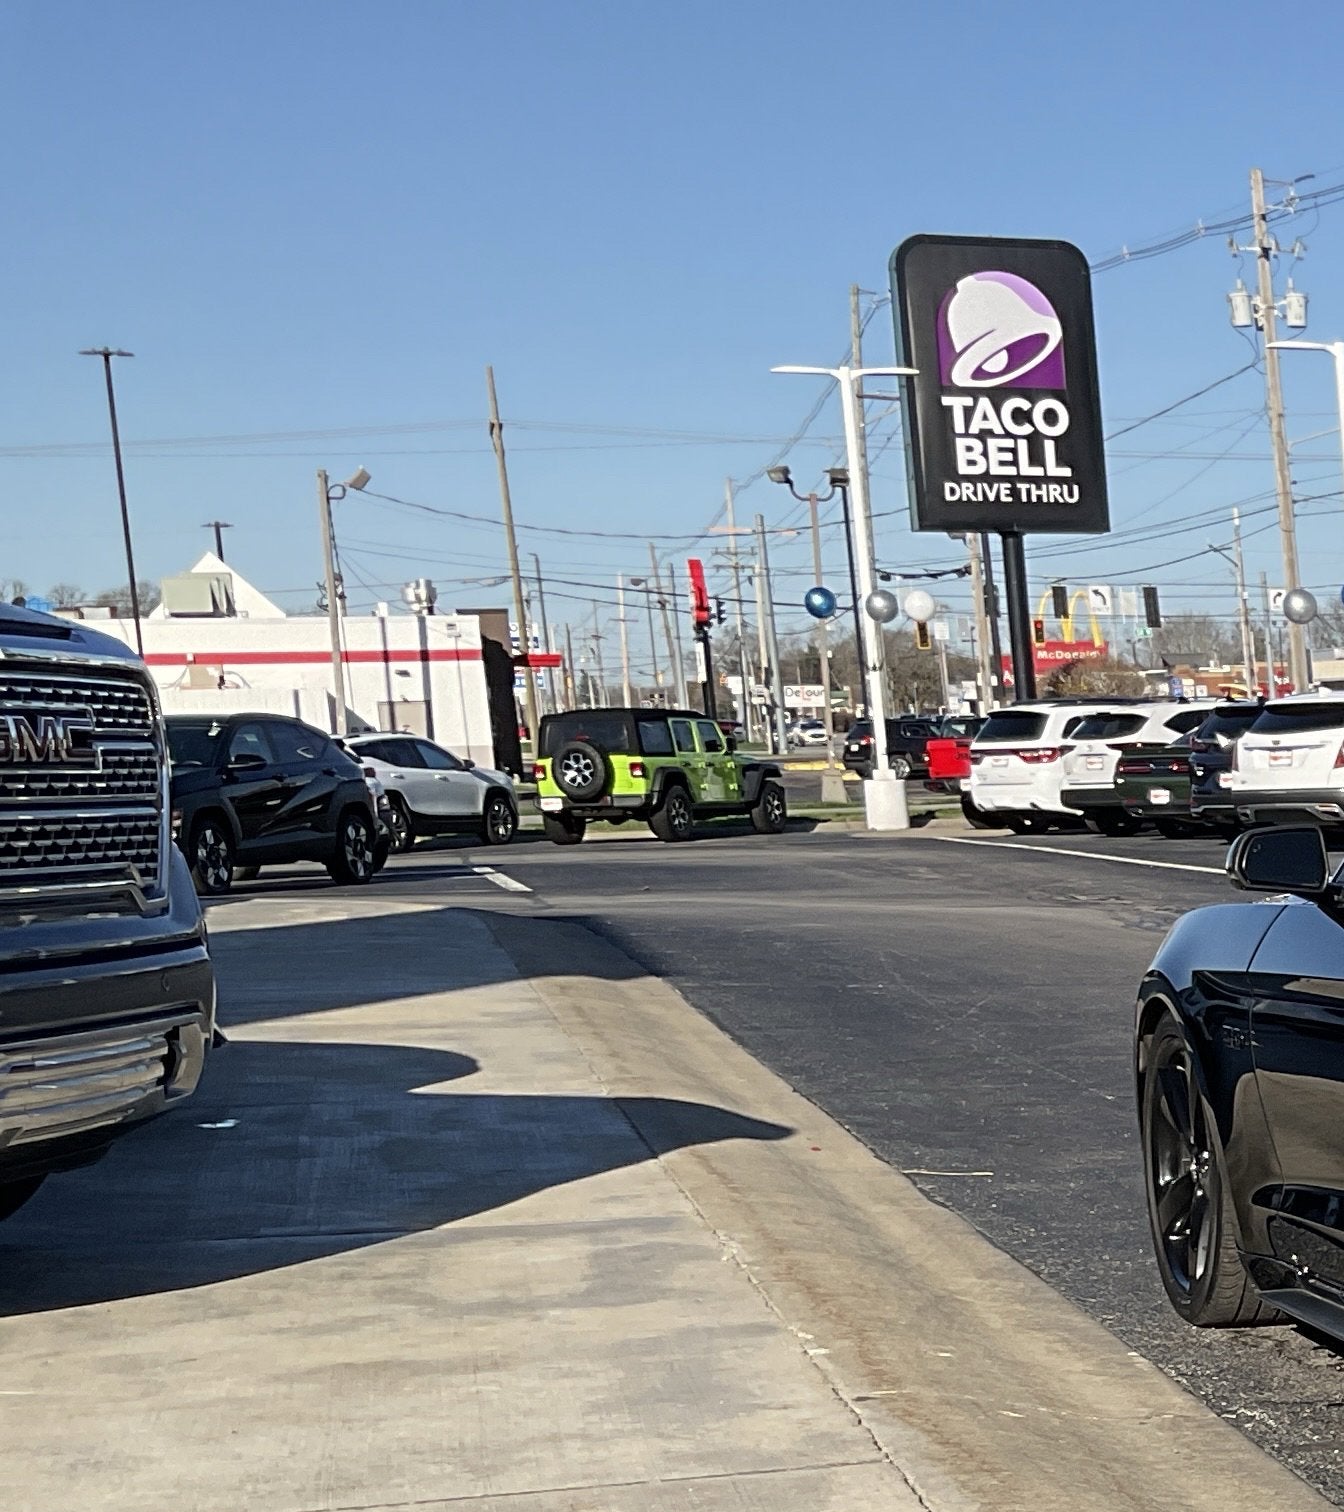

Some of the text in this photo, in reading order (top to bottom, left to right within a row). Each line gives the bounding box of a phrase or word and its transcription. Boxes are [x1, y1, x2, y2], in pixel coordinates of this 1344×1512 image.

[940, 396, 1070, 437] TACO
[955, 437, 1073, 478] BELL
[944, 482, 1080, 504] DRIVE THRU
